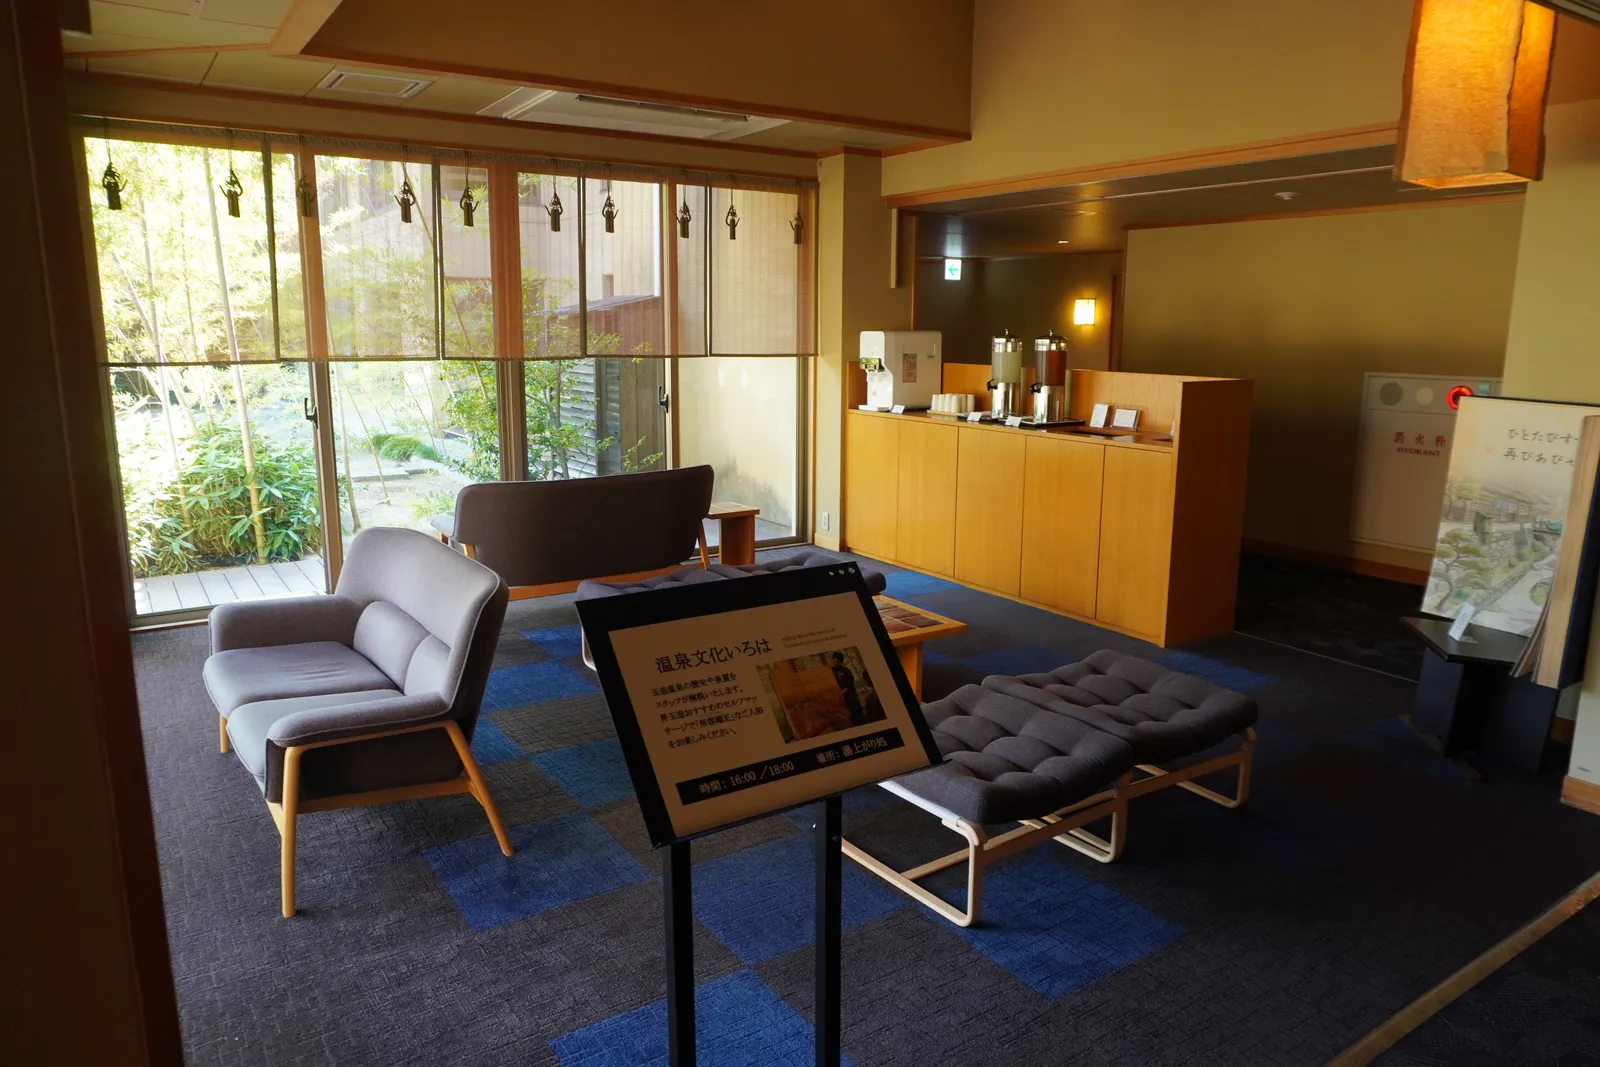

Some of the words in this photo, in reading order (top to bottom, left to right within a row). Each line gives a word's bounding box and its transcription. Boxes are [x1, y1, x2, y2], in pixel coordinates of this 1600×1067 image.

[1394, 431, 1446, 448] 消火栓
[1508, 428, 1579, 444] ひとたびす
[1397, 447, 1441, 457] HYDRANT
[655, 638, 773, 674] 温泉文化いろは
